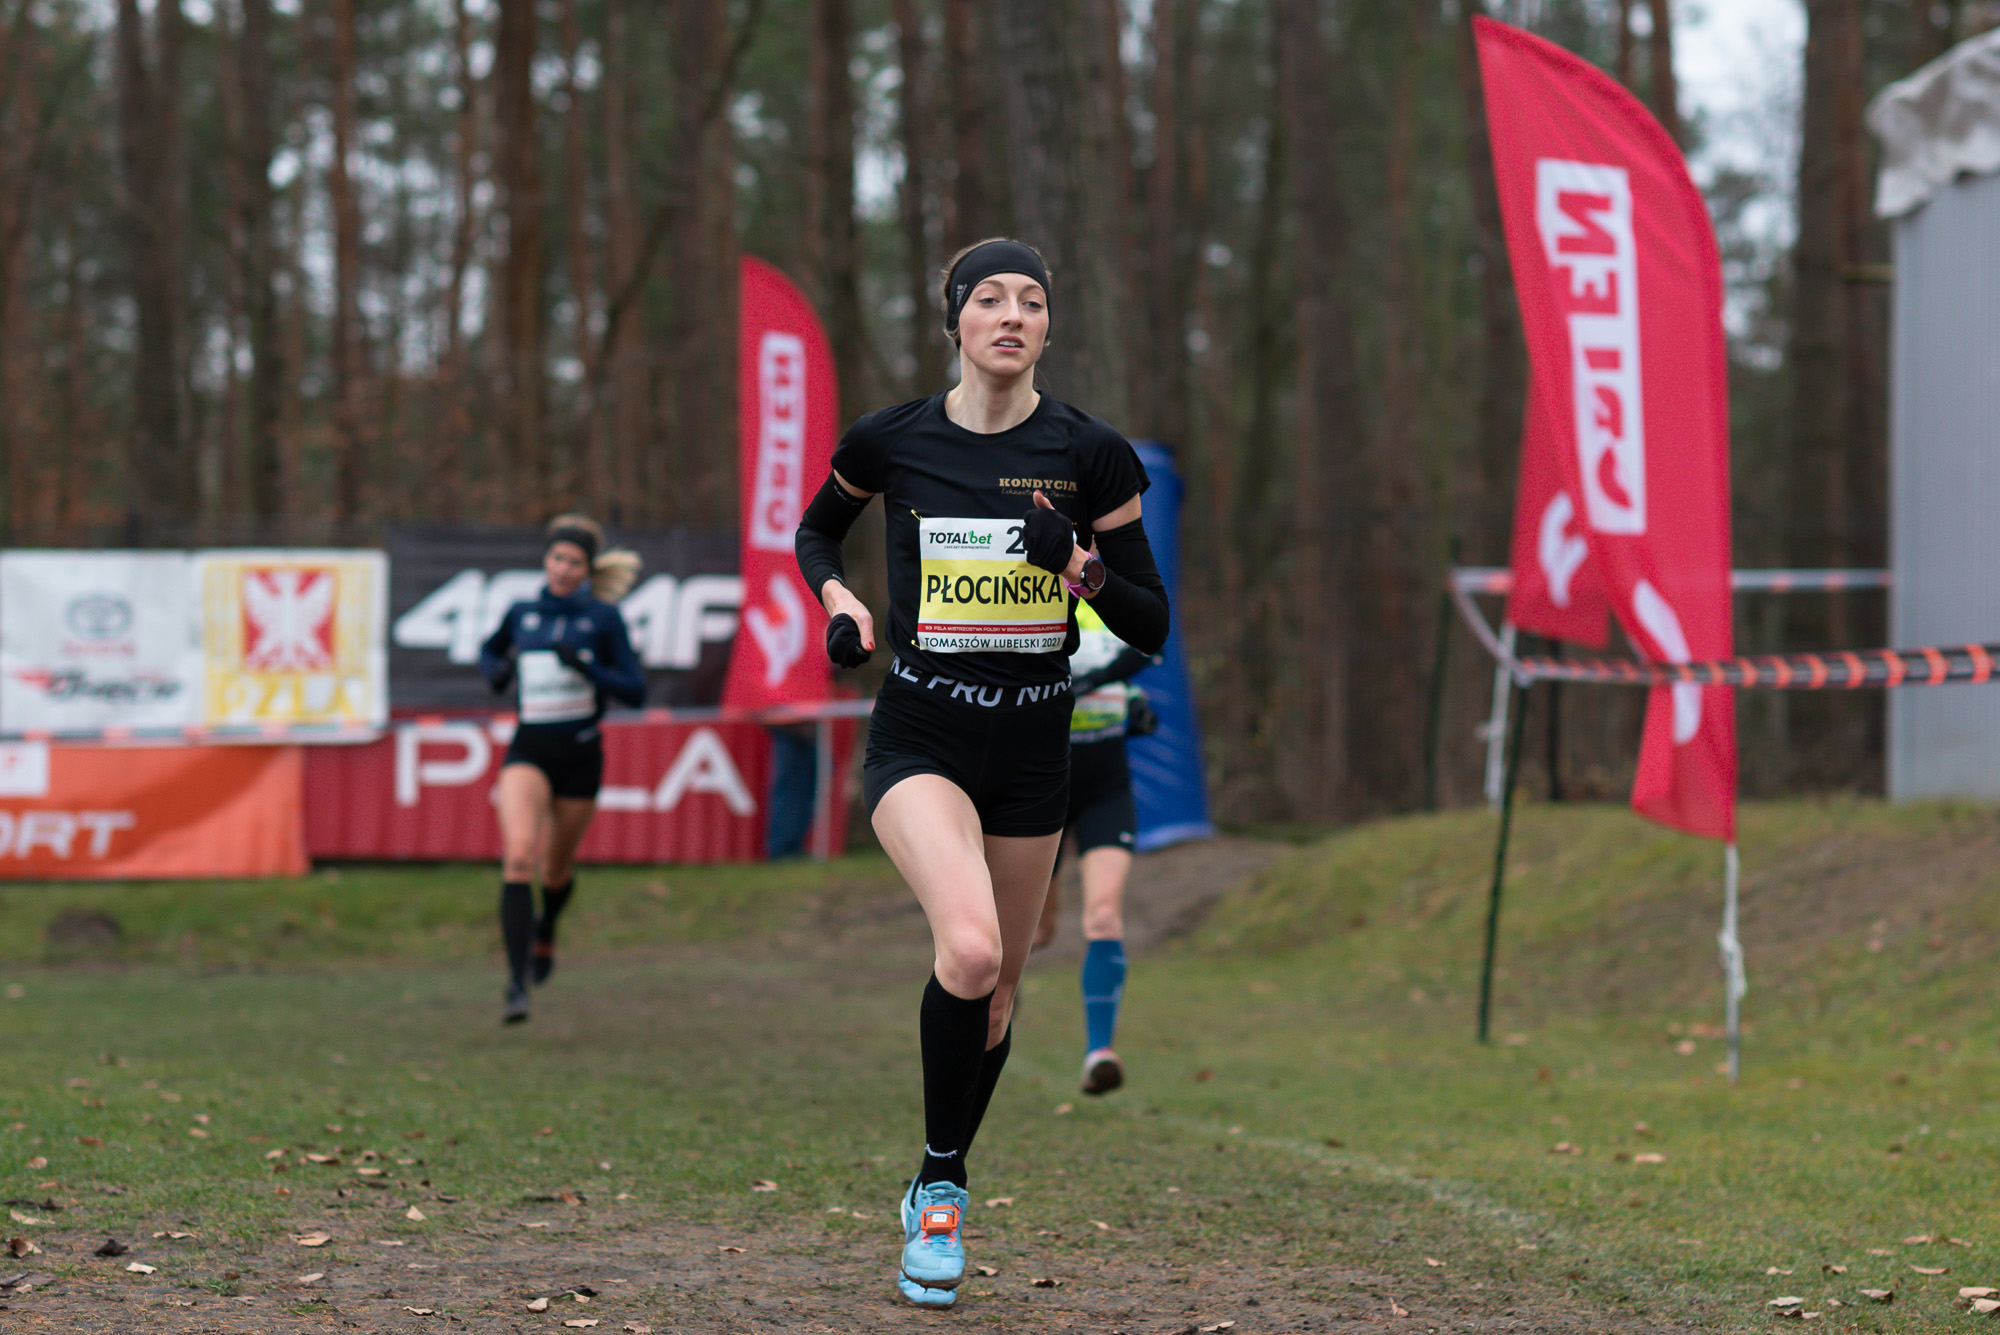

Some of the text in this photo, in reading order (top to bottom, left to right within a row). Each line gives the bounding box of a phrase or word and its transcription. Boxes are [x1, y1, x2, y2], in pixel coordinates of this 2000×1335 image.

[929, 530, 993, 545] TOTALbet
[926, 570, 1063, 605] PŁOCIŃSKA
[924, 636, 1062, 649] TOMASZÓW LUBELSKI 2021
